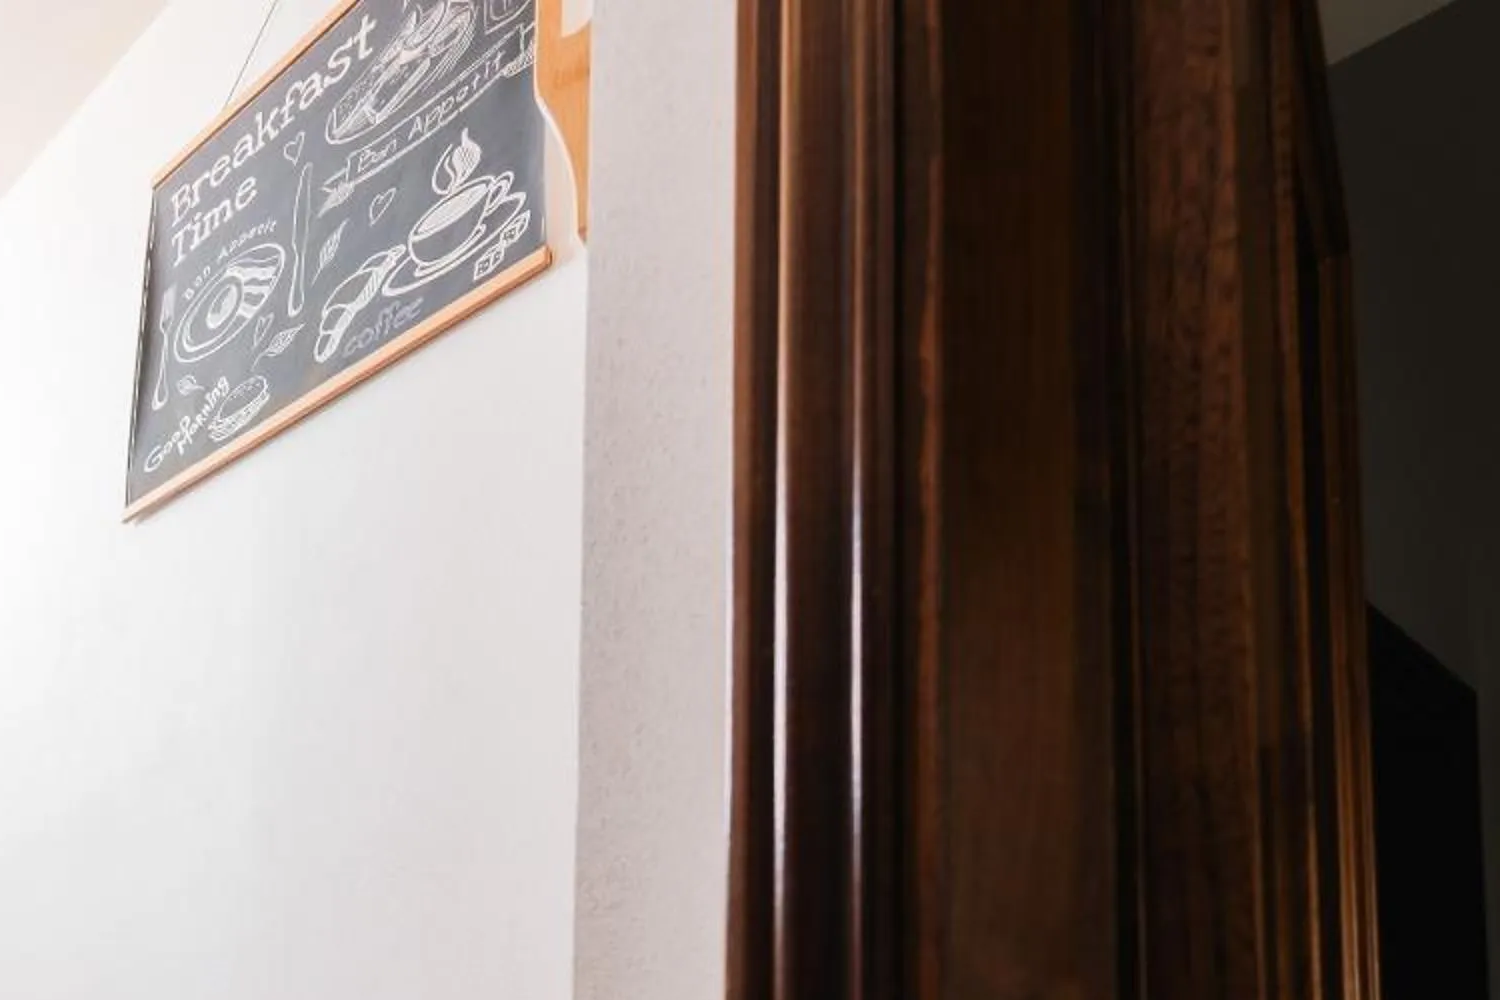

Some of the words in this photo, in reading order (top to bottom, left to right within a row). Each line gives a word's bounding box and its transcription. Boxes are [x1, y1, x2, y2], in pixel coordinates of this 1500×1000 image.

[171, 14, 377, 227] Breakfast
[355, 139, 398, 173] Bon
[171, 176, 257, 267] Time
[342, 298, 424, 358] coffee
